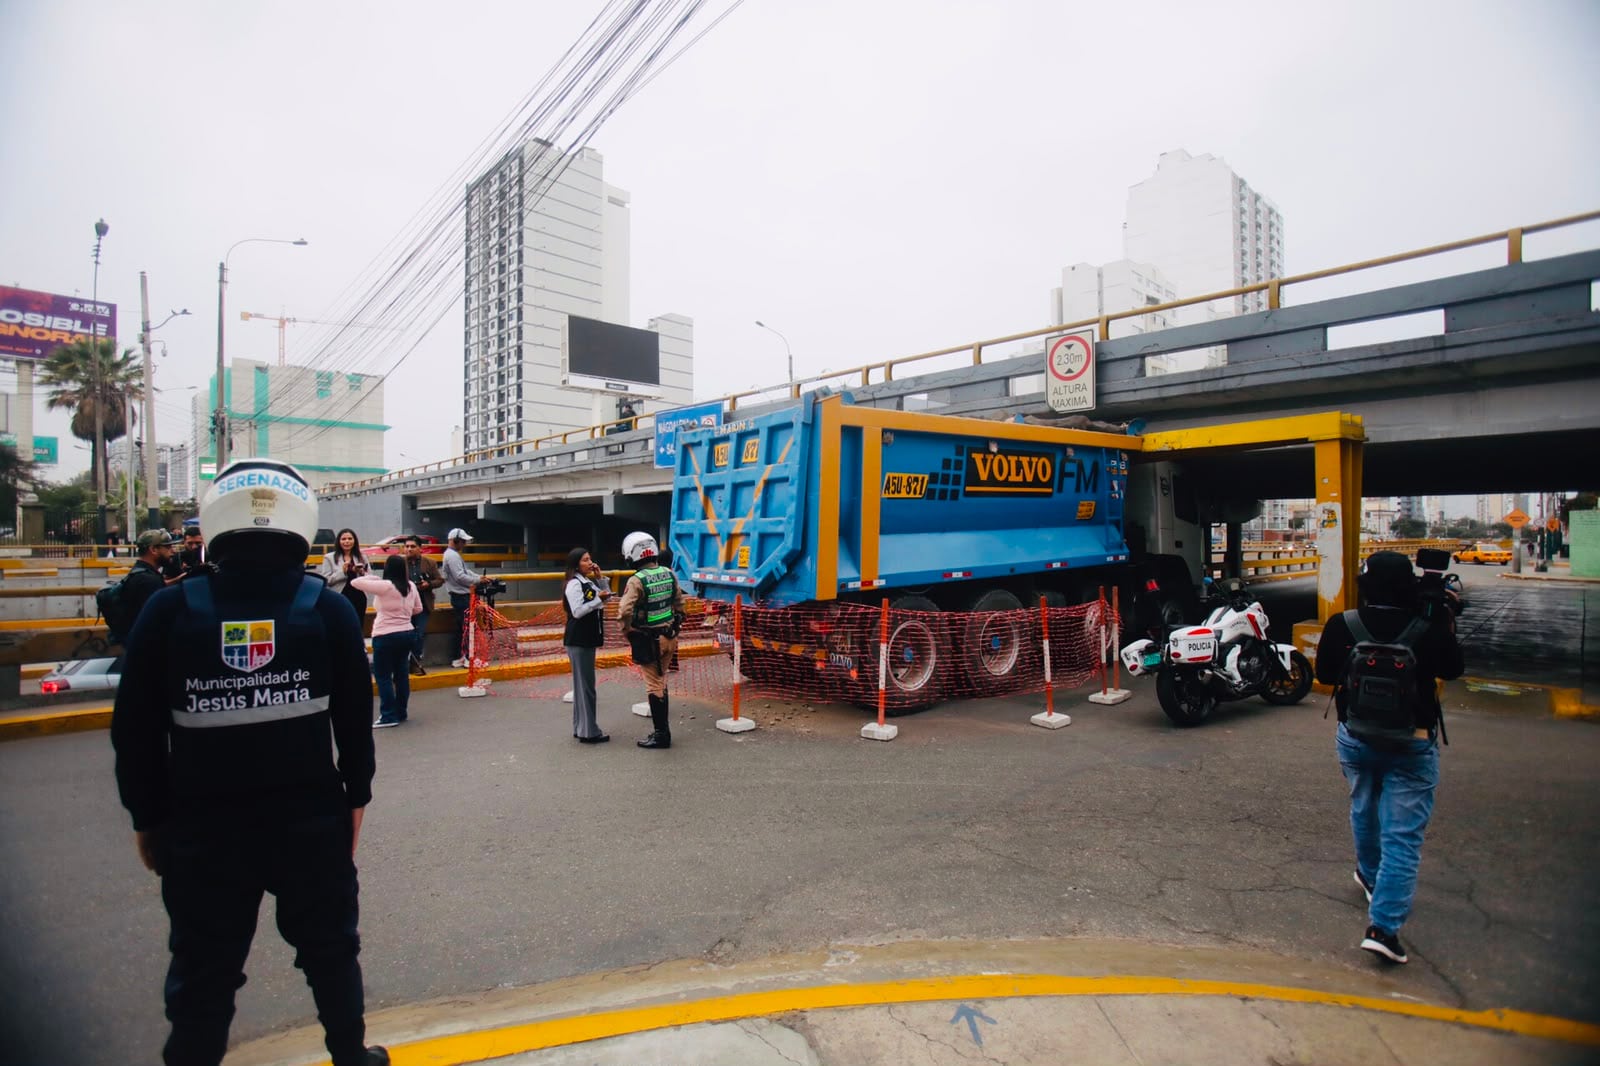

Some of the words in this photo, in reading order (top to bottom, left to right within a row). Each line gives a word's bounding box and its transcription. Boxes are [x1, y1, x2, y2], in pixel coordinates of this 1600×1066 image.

[1053, 383, 1088, 396] ALTURA
[1052, 395, 1088, 408] MAXIMA
[971, 452, 1052, 483] VOLVO
[1057, 458, 1099, 493] FM
[218, 473, 309, 501] SERENAZGO
[884, 475, 925, 496] A5U-871
[1188, 641, 1212, 652] POLICIA
[186, 671, 289, 691] Municipalidad
[293, 669, 310, 681] de
[186, 691, 247, 713] Jesús
[253, 684, 310, 708] María
